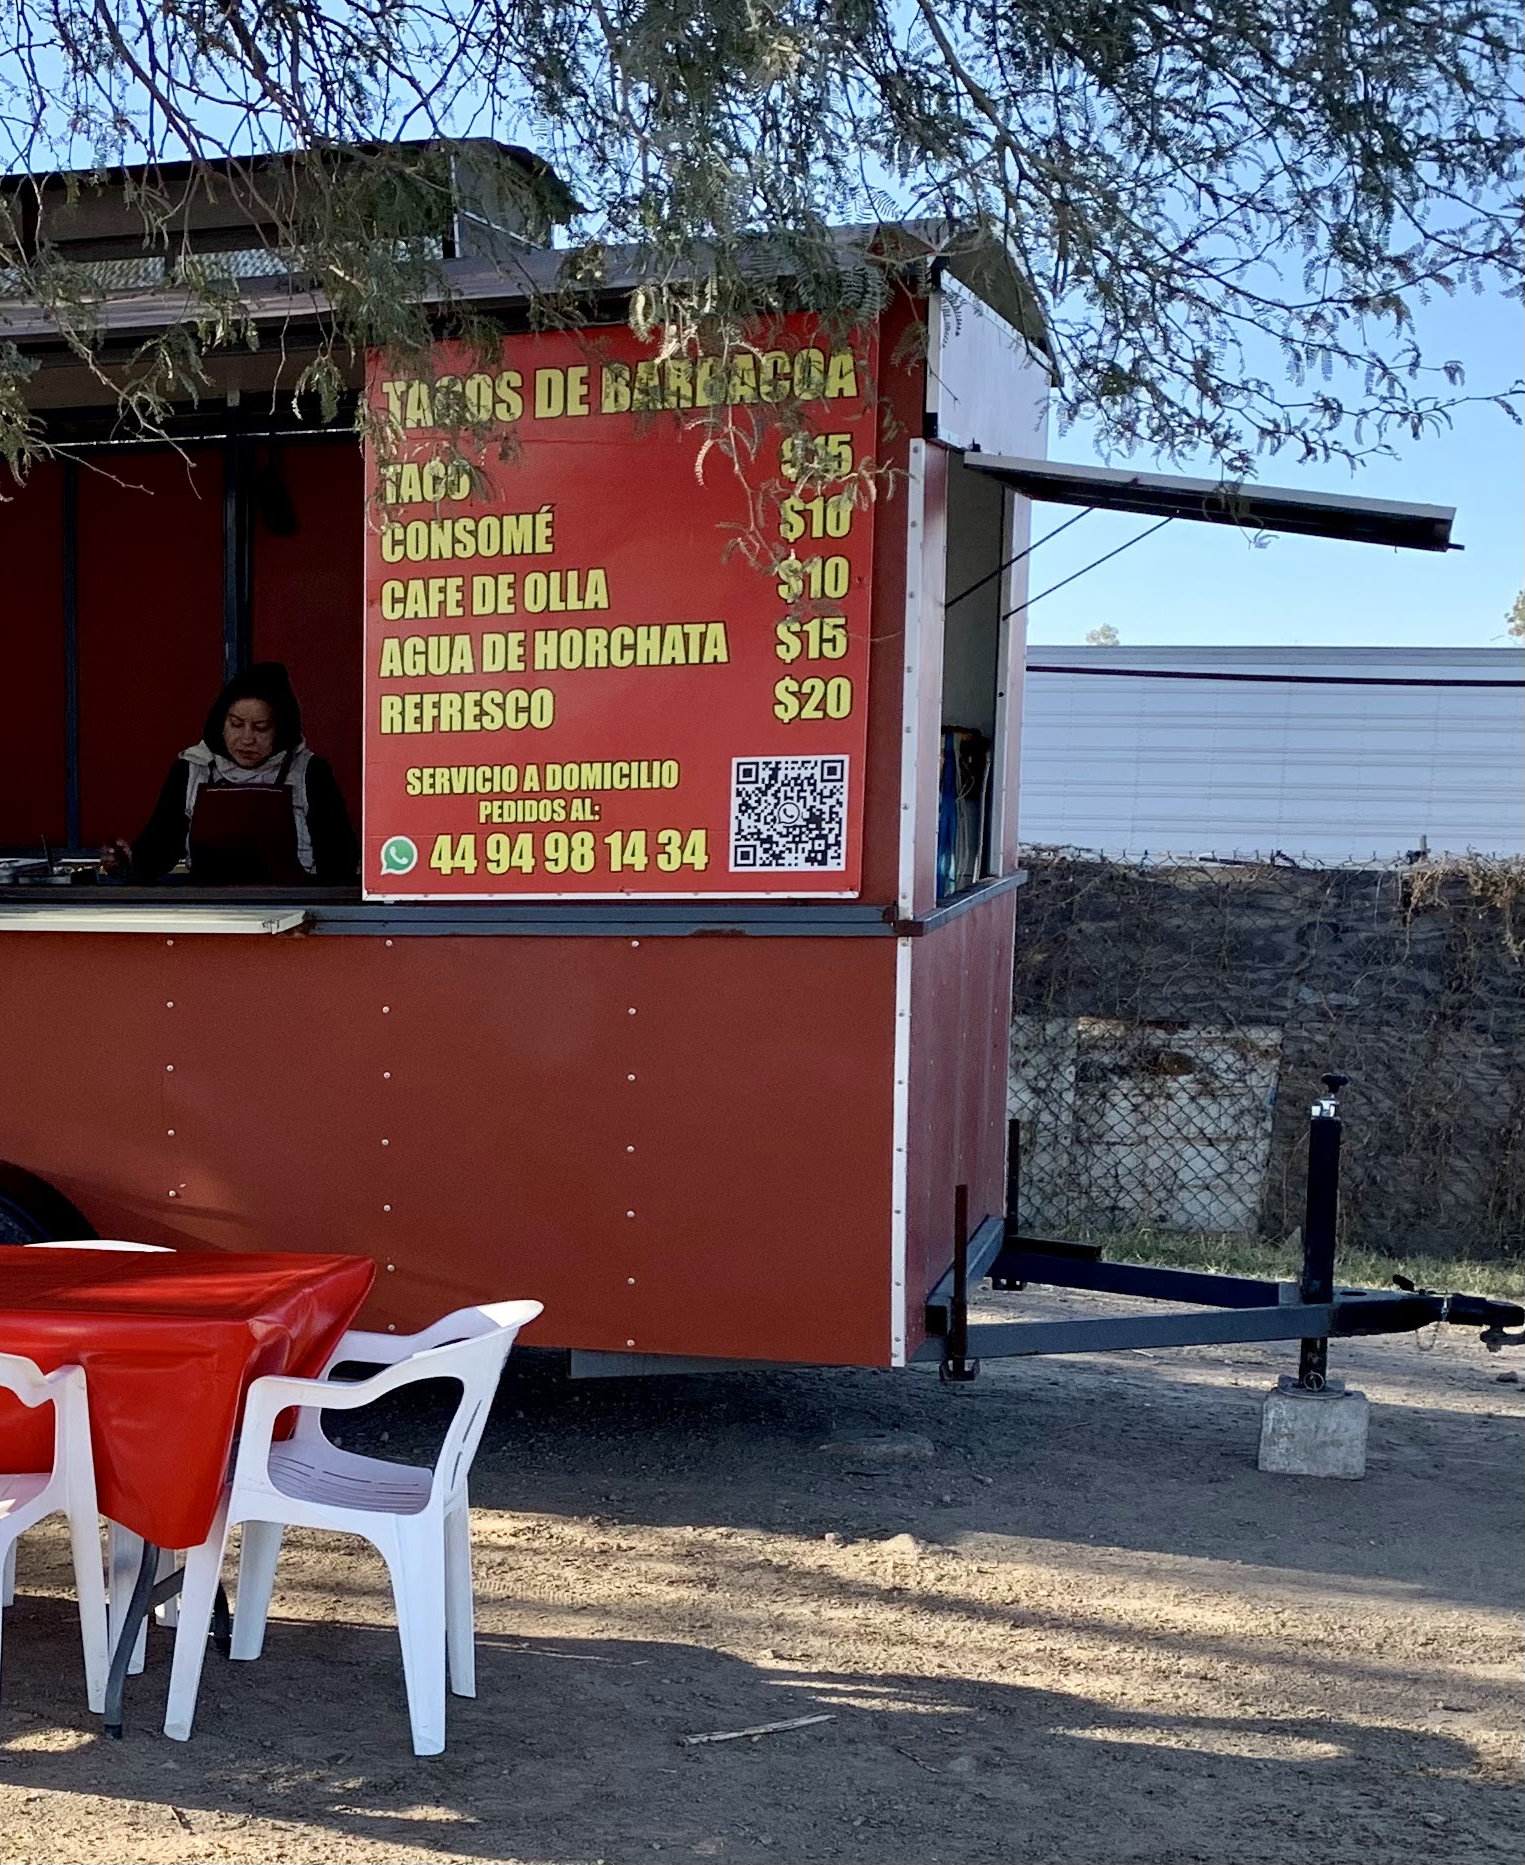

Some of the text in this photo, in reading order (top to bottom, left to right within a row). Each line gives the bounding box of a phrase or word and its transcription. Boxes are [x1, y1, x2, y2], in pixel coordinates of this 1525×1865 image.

[534, 366, 590, 419] DE
[385, 459, 471, 504] TACO
[381, 496, 852, 563] CONSOMÉ $10
[381, 554, 849, 621] CAFE DE OLLA $10
[380, 616, 848, 677] AGUA DE HORCHATA $15
[380, 676, 851, 734] REFRESCO $20
[406, 760, 679, 796] SERVICIO A DOMICILIO
[479, 798, 600, 824] PEDIDOS AL:
[430, 829, 709, 875] 44 94 98 14 34
